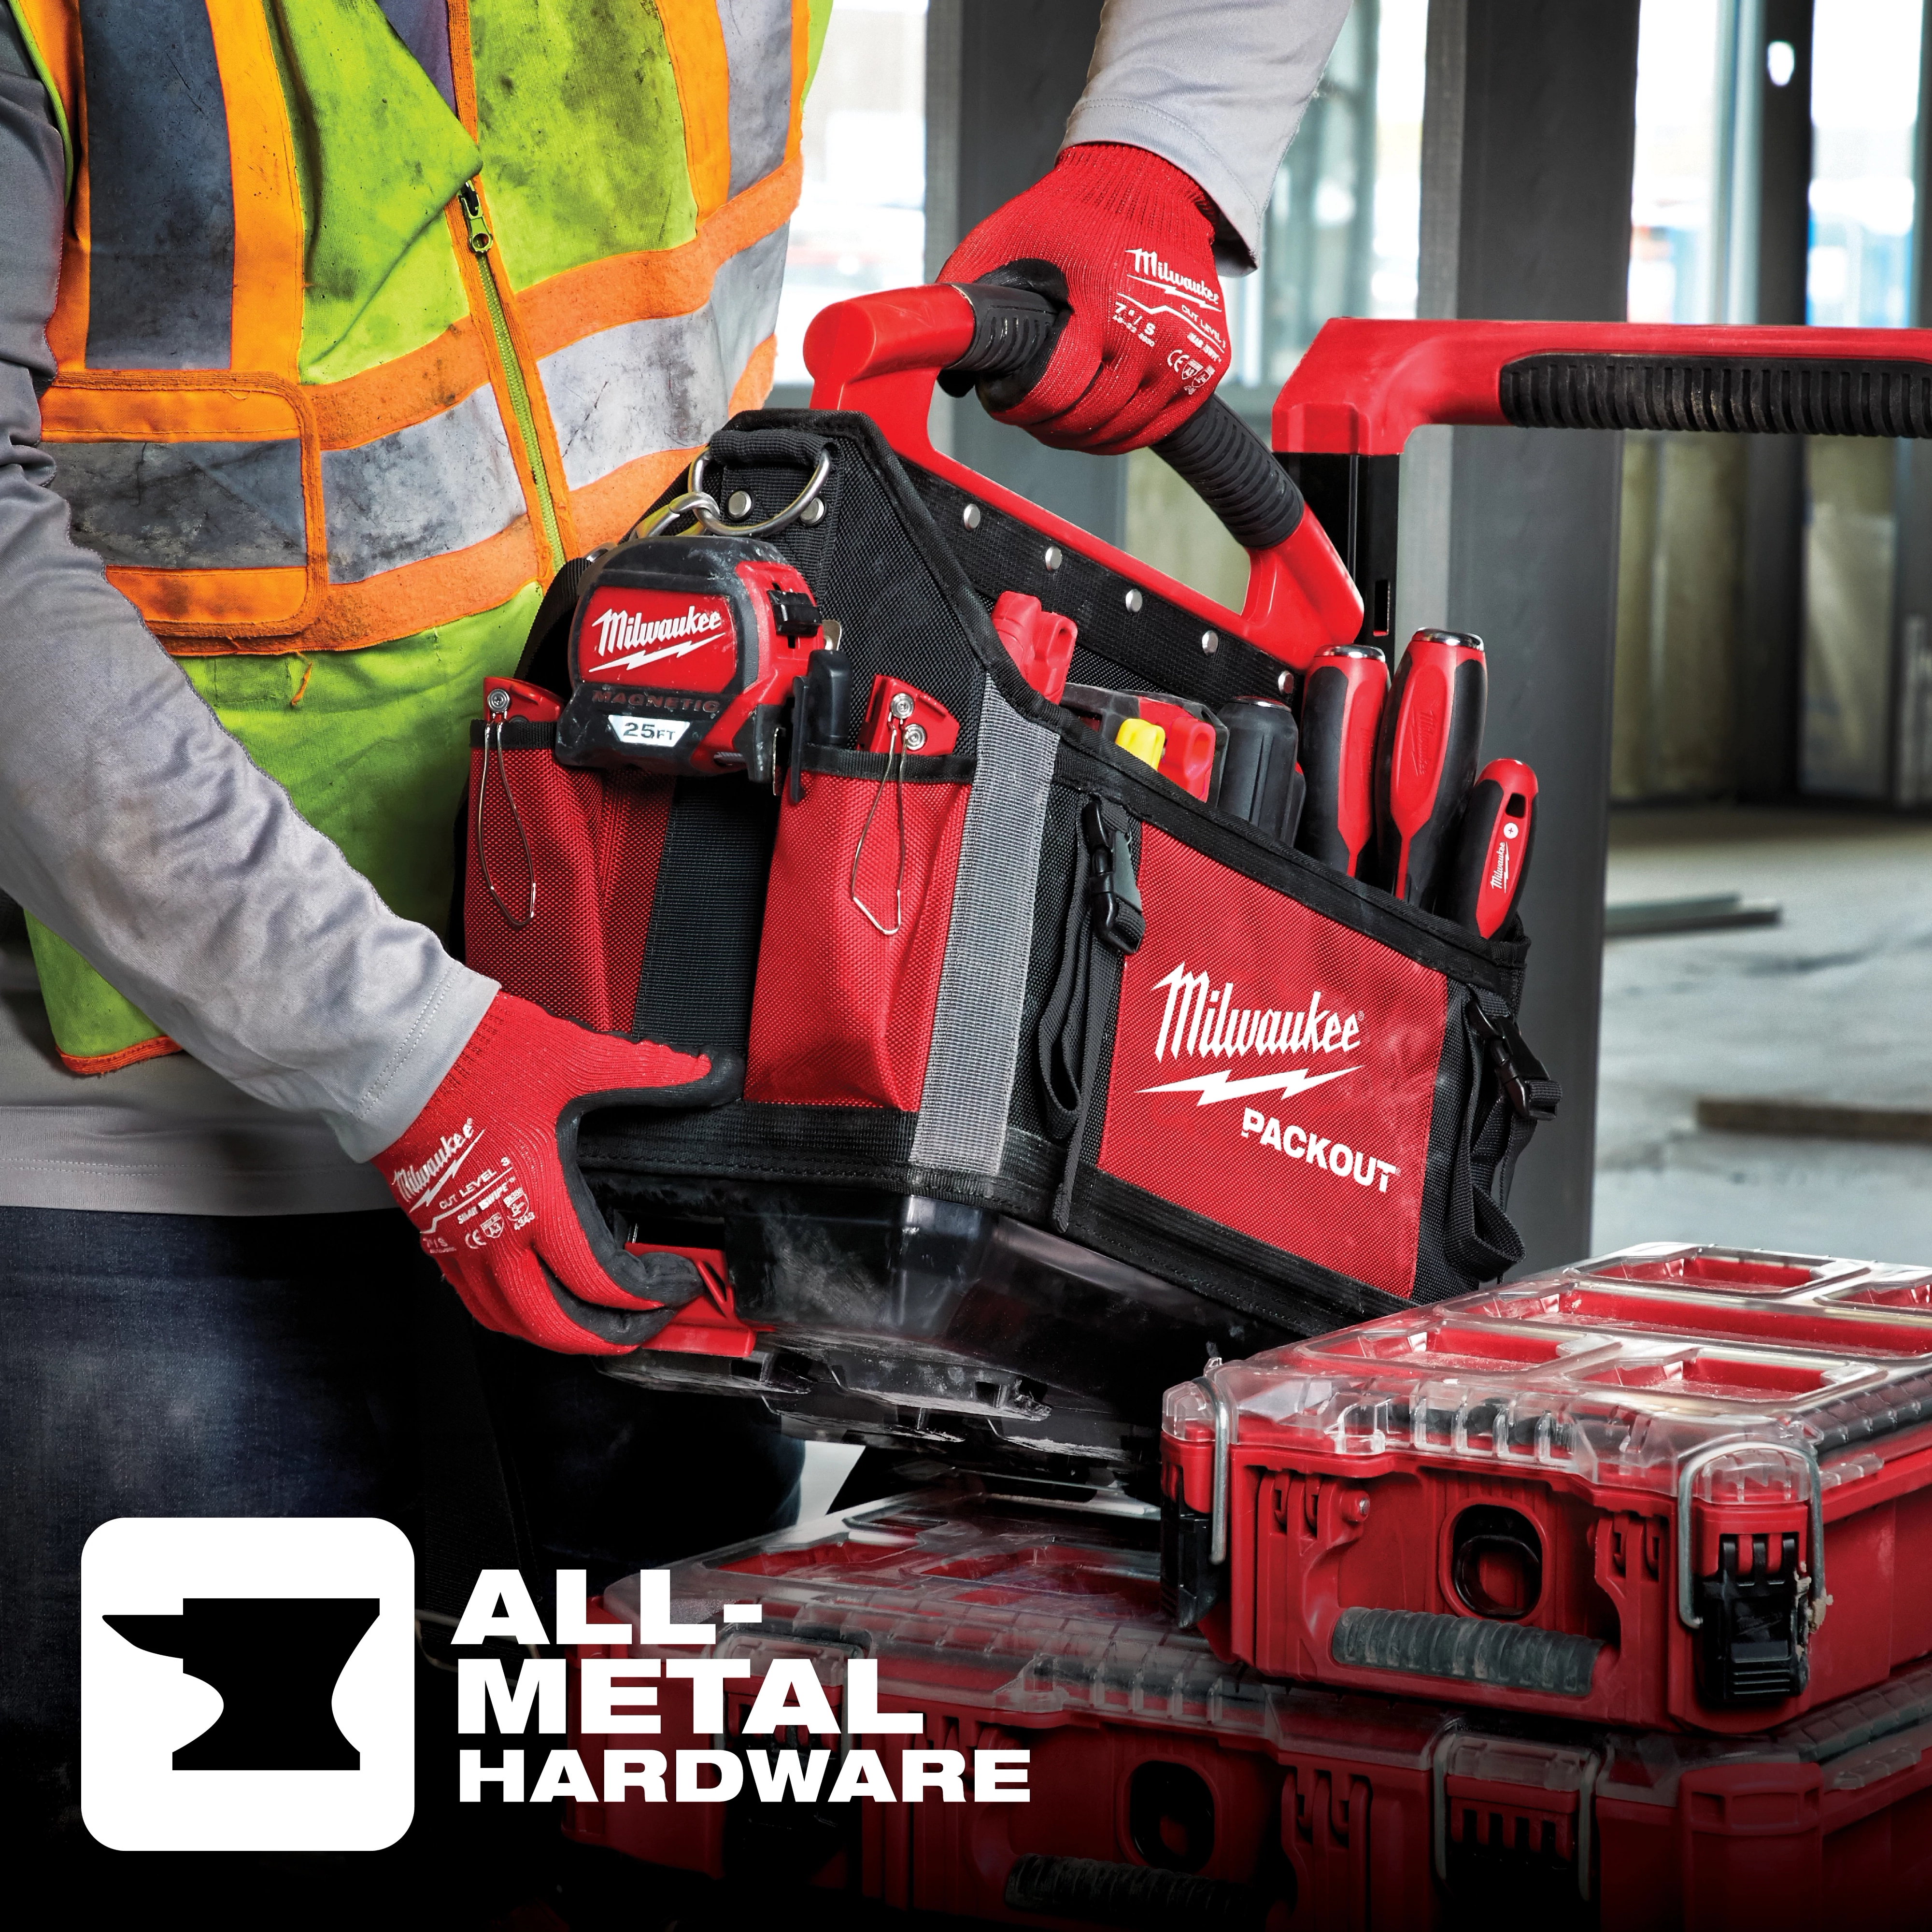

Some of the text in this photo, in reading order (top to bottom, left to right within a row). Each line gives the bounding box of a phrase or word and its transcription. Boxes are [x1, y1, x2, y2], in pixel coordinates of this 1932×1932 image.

[1125, 248, 1219, 305] Milwaukee
[592, 606, 722, 656] Milwaukee
[592, 690, 721, 713] MAGNETIC
[1490, 842, 1506, 889] Milwaukee
[439, 1194, 457, 1209] CUT
[459, 1168, 497, 1197] LEVEL
[500, 1156, 510, 1166] 3
[514, 1212, 535, 1230] 4343
